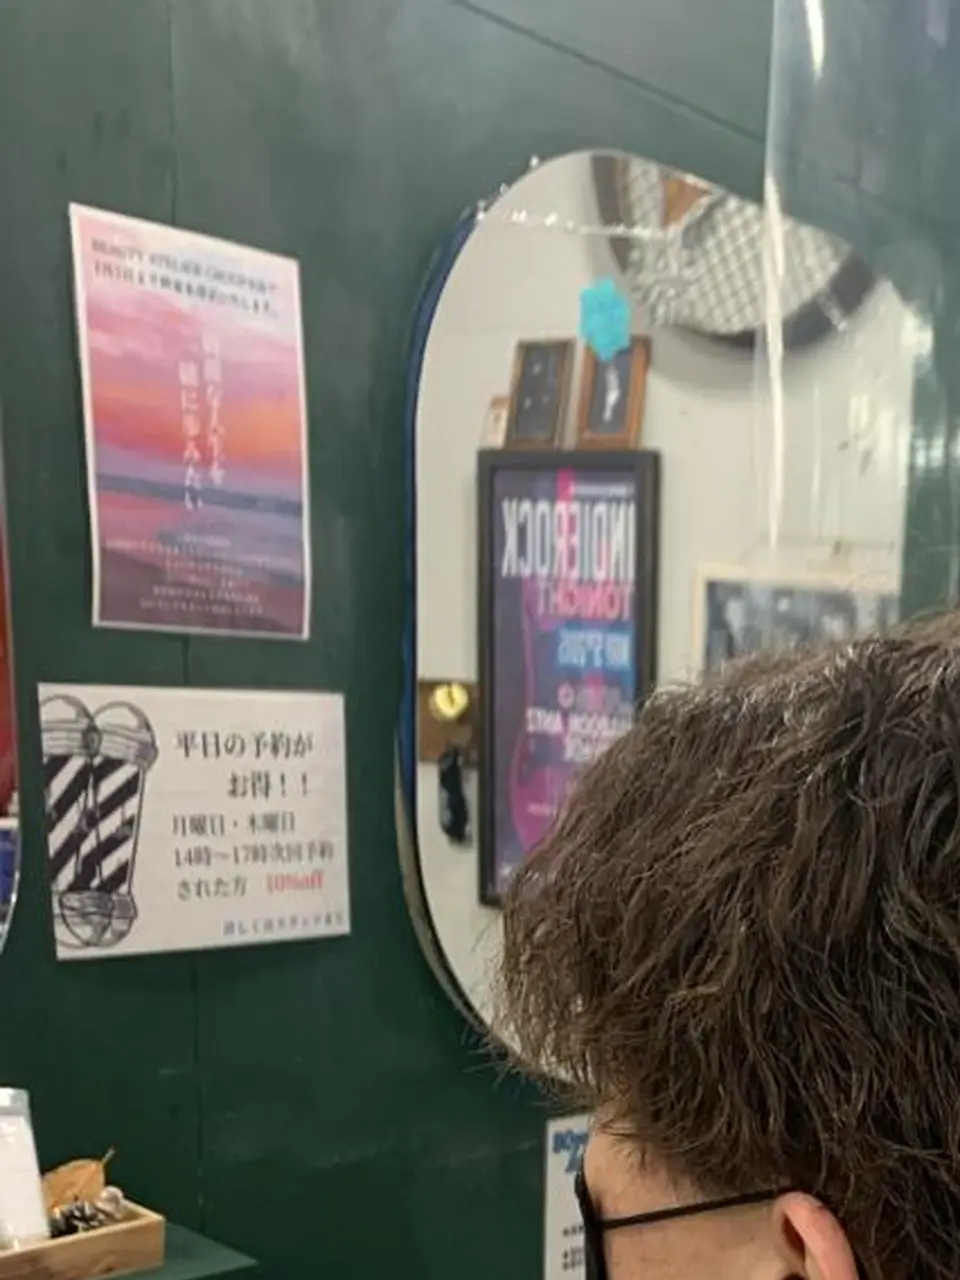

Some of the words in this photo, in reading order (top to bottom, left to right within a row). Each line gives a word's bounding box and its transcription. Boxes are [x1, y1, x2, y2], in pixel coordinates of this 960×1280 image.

[174, 730, 313, 760] 平日の予約が
[177, 874, 248, 901] された方
